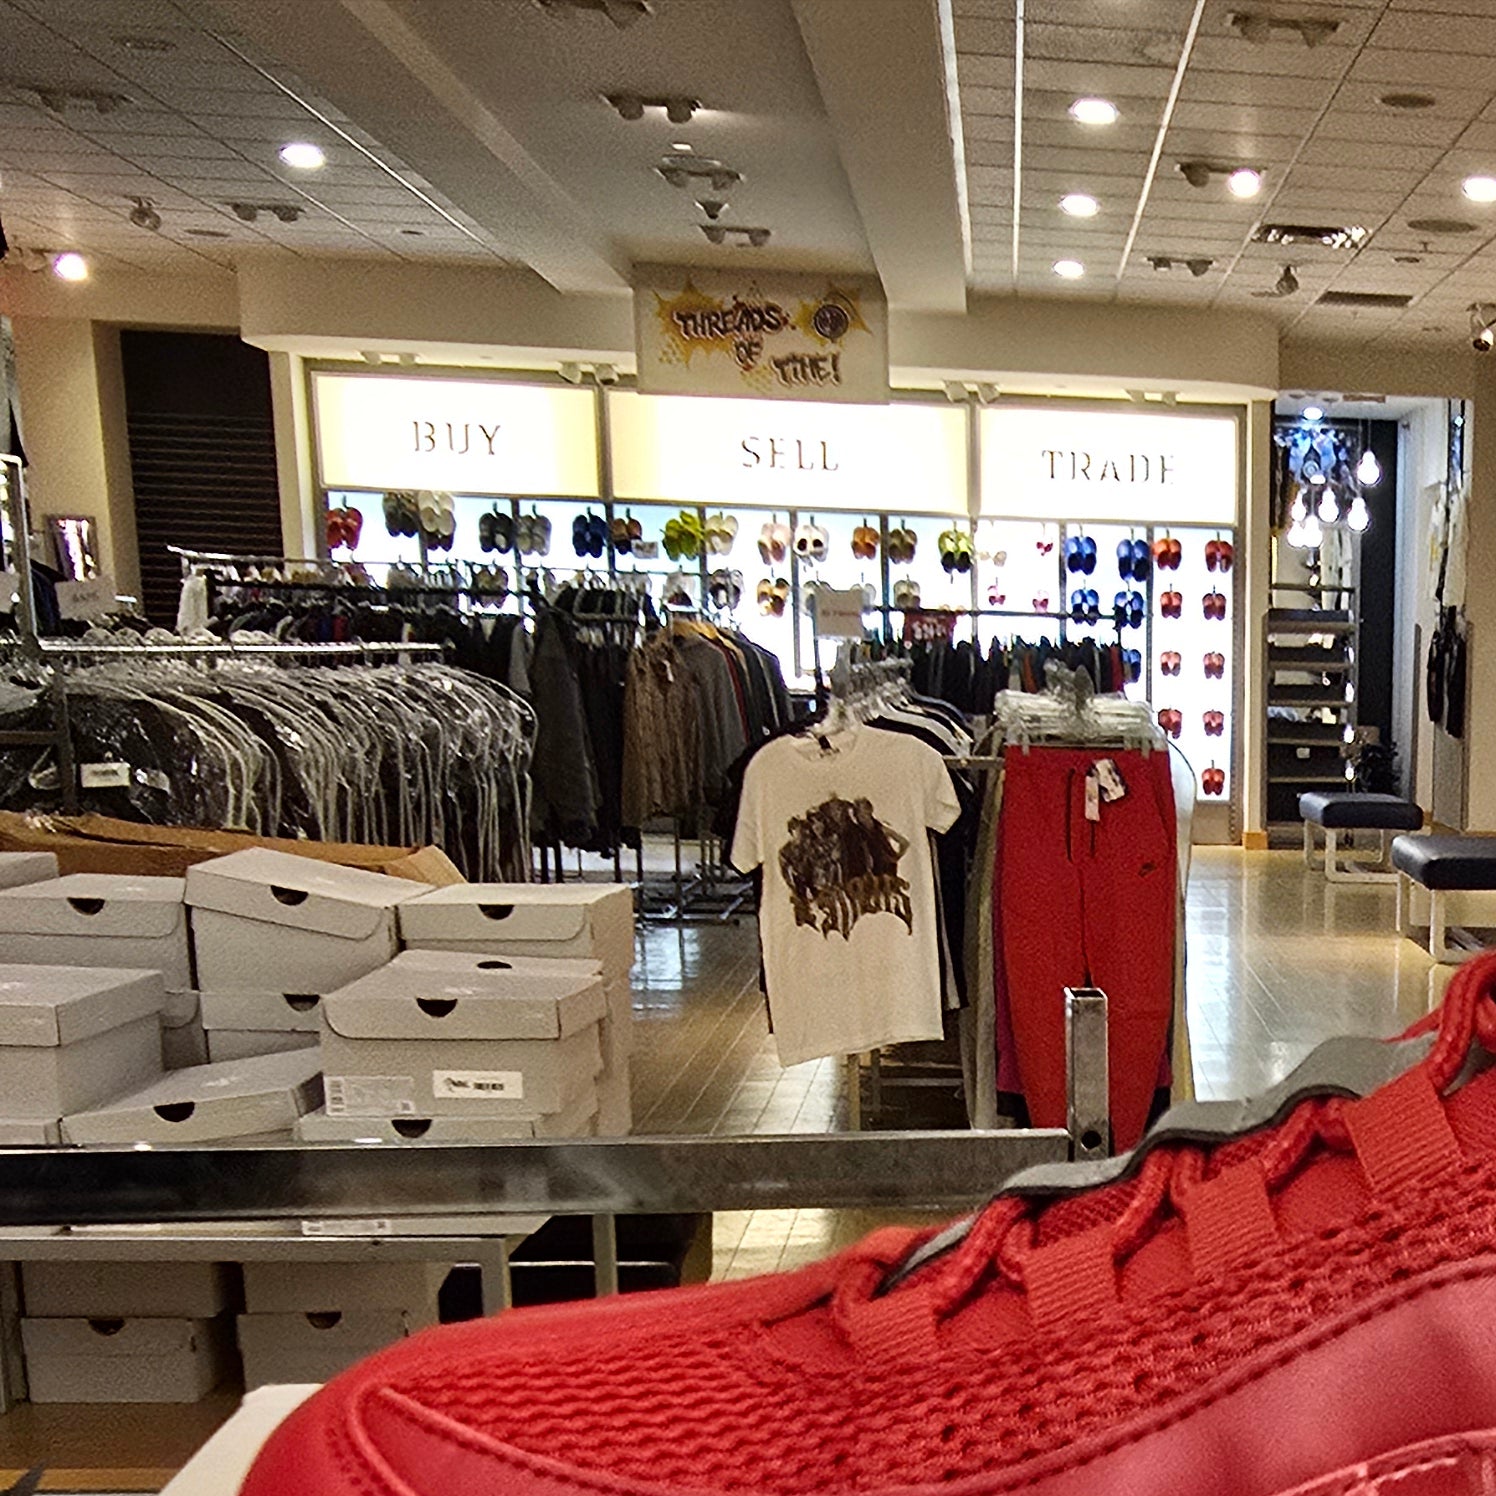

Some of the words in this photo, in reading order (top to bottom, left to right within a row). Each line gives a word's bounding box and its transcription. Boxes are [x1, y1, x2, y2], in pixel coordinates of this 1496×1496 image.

[672, 302, 783, 341] THREADS
[733, 335, 763, 370] OF
[413, 421, 501, 455] BUY
[741, 436, 839, 471] SELL
[1041, 449, 1174, 484] TRADE
